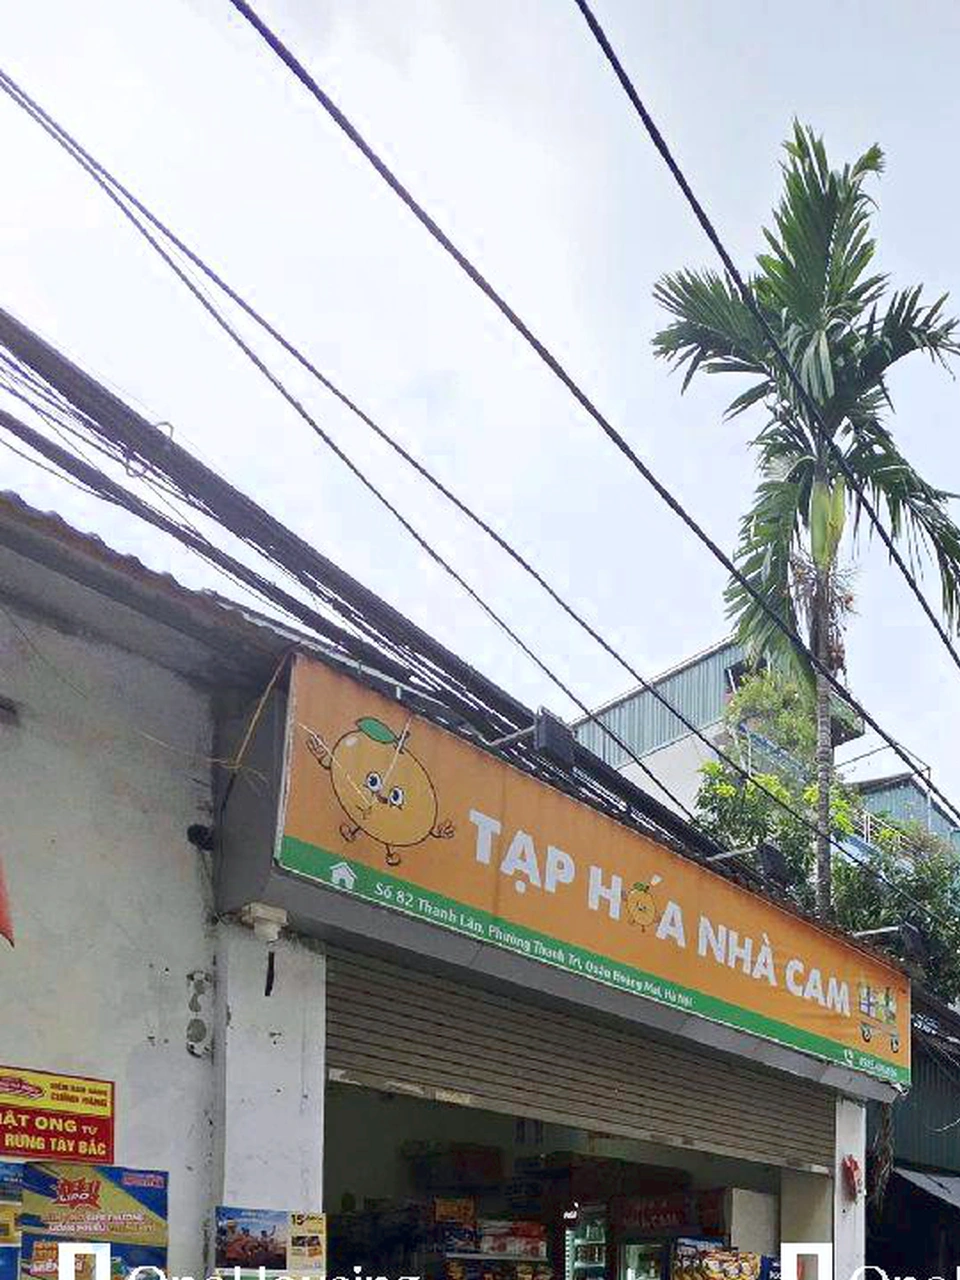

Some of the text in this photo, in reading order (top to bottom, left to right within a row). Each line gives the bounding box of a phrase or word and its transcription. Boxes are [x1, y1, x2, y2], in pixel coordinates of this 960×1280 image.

[374, 882, 392, 899] Số
[396, 890, 414, 908] 82
[418, 898, 457, 925] Thanh
[468, 809, 576, 894] TẠP
[698, 915, 778, 987] NHÀ
[785, 958, 851, 1018] CAM
[35, 1116, 77, 1132] ONG
[50, 1136, 75, 1152] TÂY
[78, 1138, 107, 1155] BẮC
